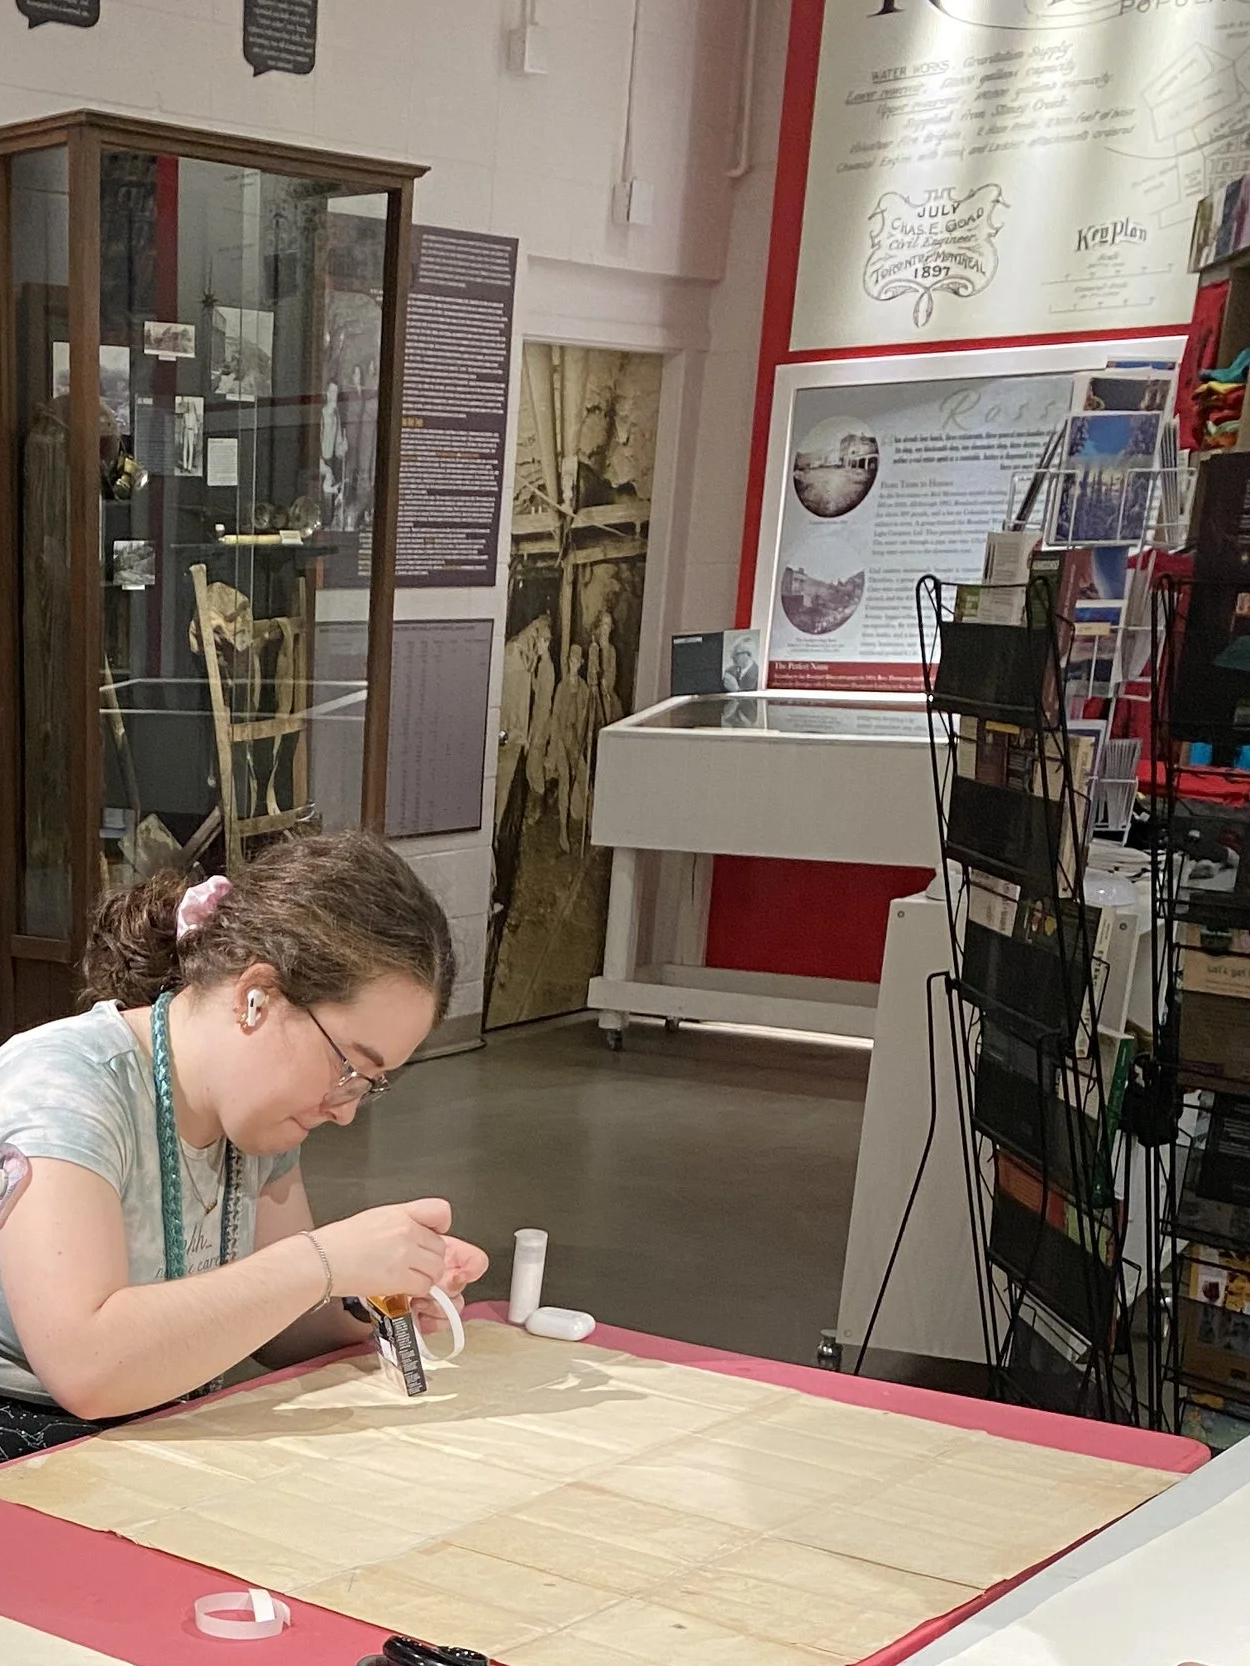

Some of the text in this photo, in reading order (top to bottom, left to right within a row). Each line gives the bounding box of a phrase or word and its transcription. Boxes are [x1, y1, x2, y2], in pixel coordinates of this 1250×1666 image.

[871, 66, 907, 82] WATER
[917, 202, 961, 218] JULY
[945, 207, 985, 233] GOAD
[1075, 216, 1148, 252] Key Plan
[889, 235, 920, 250] Civil
[934, 250, 987, 276] MONTREAL
[914, 265, 950, 279] 1897
